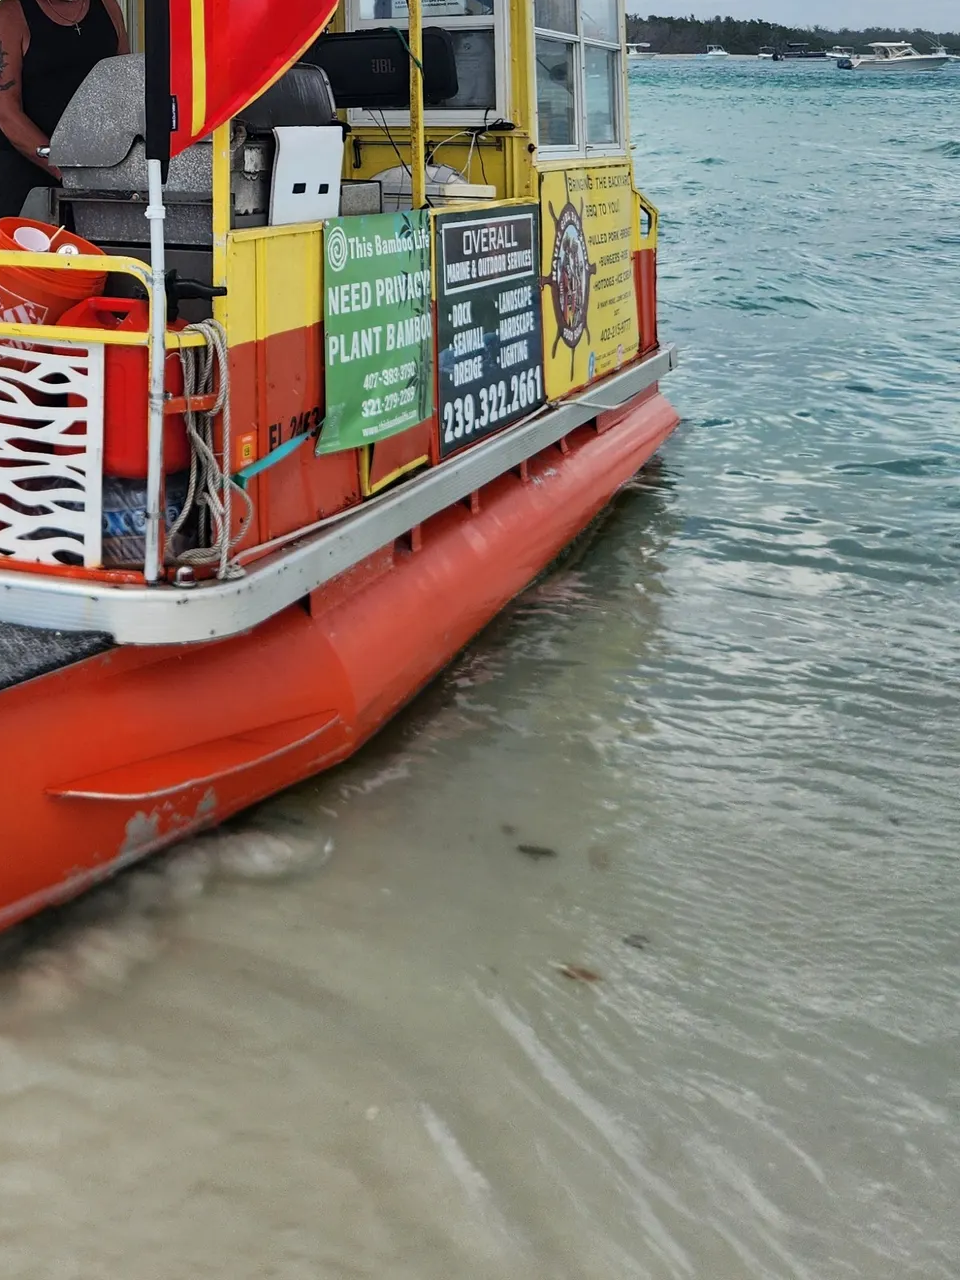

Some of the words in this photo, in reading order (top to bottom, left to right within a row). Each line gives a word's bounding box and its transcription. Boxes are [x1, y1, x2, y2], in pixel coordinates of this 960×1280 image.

[371, 59, 396, 74] JBL
[595, 177, 607, 190] THE
[585, 203, 598, 218] BBQ
[599, 203, 607, 216] TO
[347, 236, 373, 259] This
[374, 232, 412, 256] Bamboo
[413, 228, 430, 250] Life
[463, 224, 519, 255] OVERALL
[447, 260, 471, 284] MARINE
[471, 259, 477, 279] &
[478, 253, 507, 277] OUTDOOR
[507, 249, 532, 271] SERVICES
[328, 281, 372, 316] NEED
[498, 285, 533, 314] LANDSCAPE
[452, 301, 472, 328] DOCK
[499, 310, 535, 342] HARDSCAPE
[328, 326, 382, 366] PLANT
[453, 326, 485, 358] SEAWALL
[500, 339, 529, 369] LIGHTING
[453, 355, 483, 387] DREDGE
[443, 365, 541, 444] 239.322.2661
